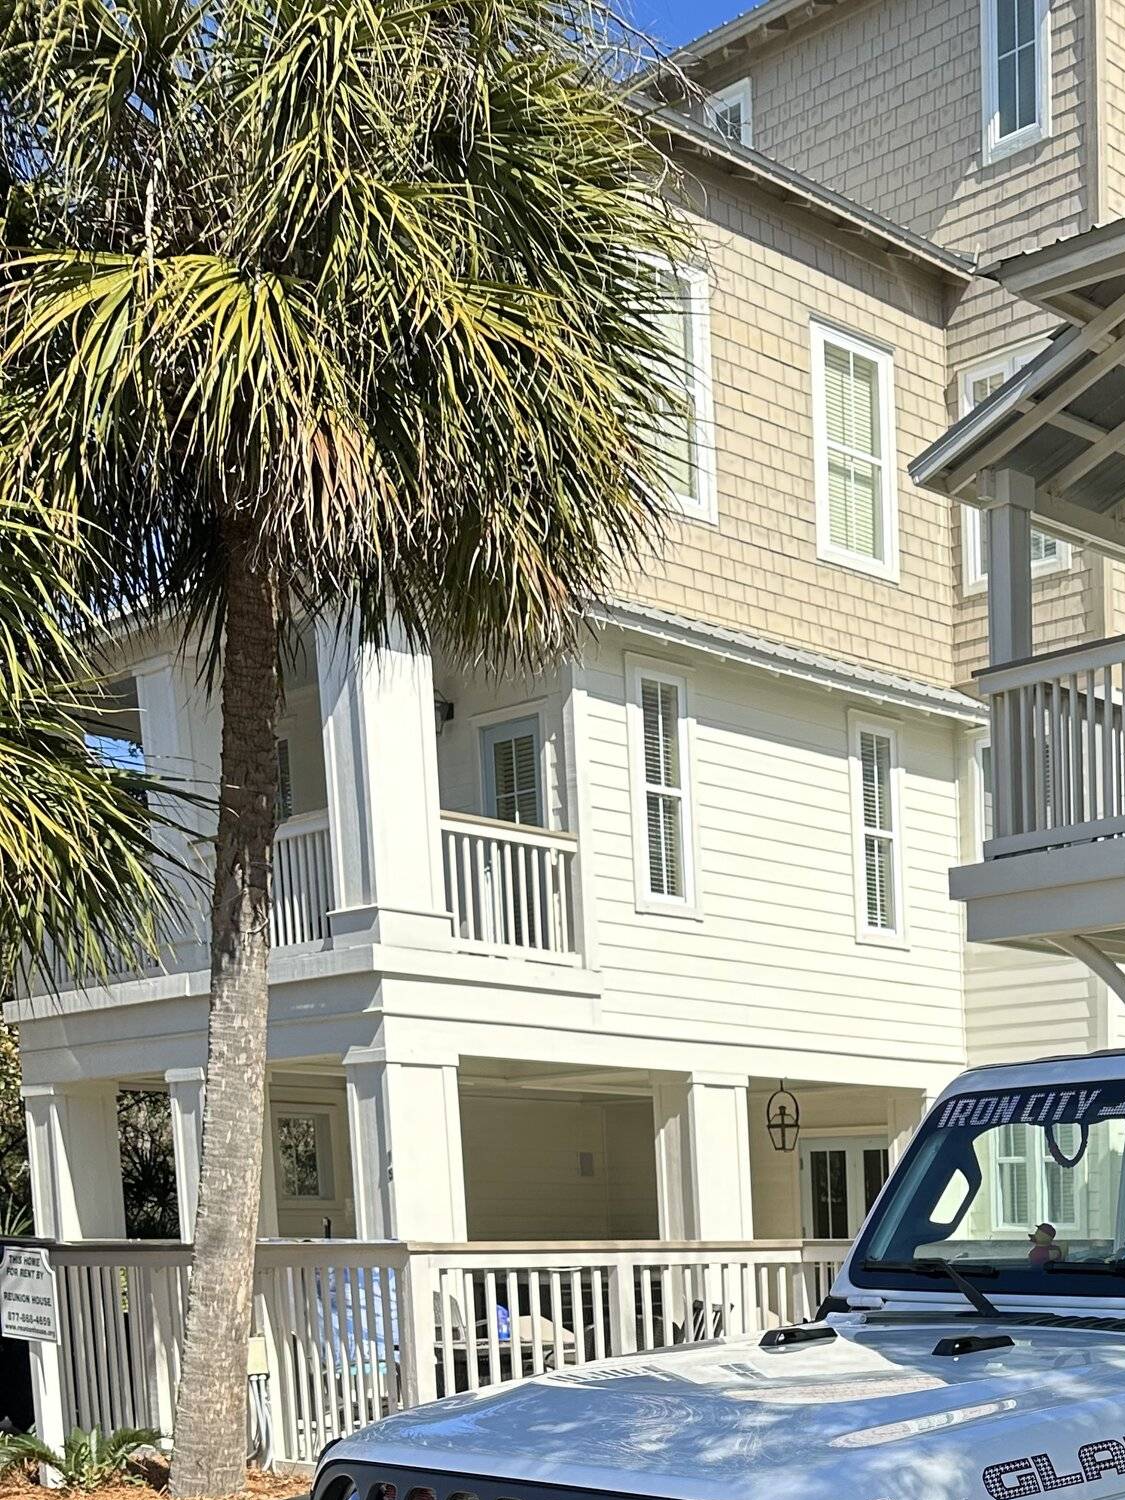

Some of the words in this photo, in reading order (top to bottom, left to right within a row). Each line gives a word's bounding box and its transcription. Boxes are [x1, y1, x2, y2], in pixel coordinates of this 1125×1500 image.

[937, 1093, 1021, 1129] IRON
[1020, 1088, 1102, 1123] CITY
[9, 1254, 22, 1265] THIS
[23, 1256, 40, 1267] HOME
[6, 1267, 18, 1276] FOR
[20, 1268, 35, 1278] RENT
[36, 1271, 44, 1280] BY
[3, 1291, 31, 1303] REUNION
[31, 1296, 52, 1307] HOUSE
